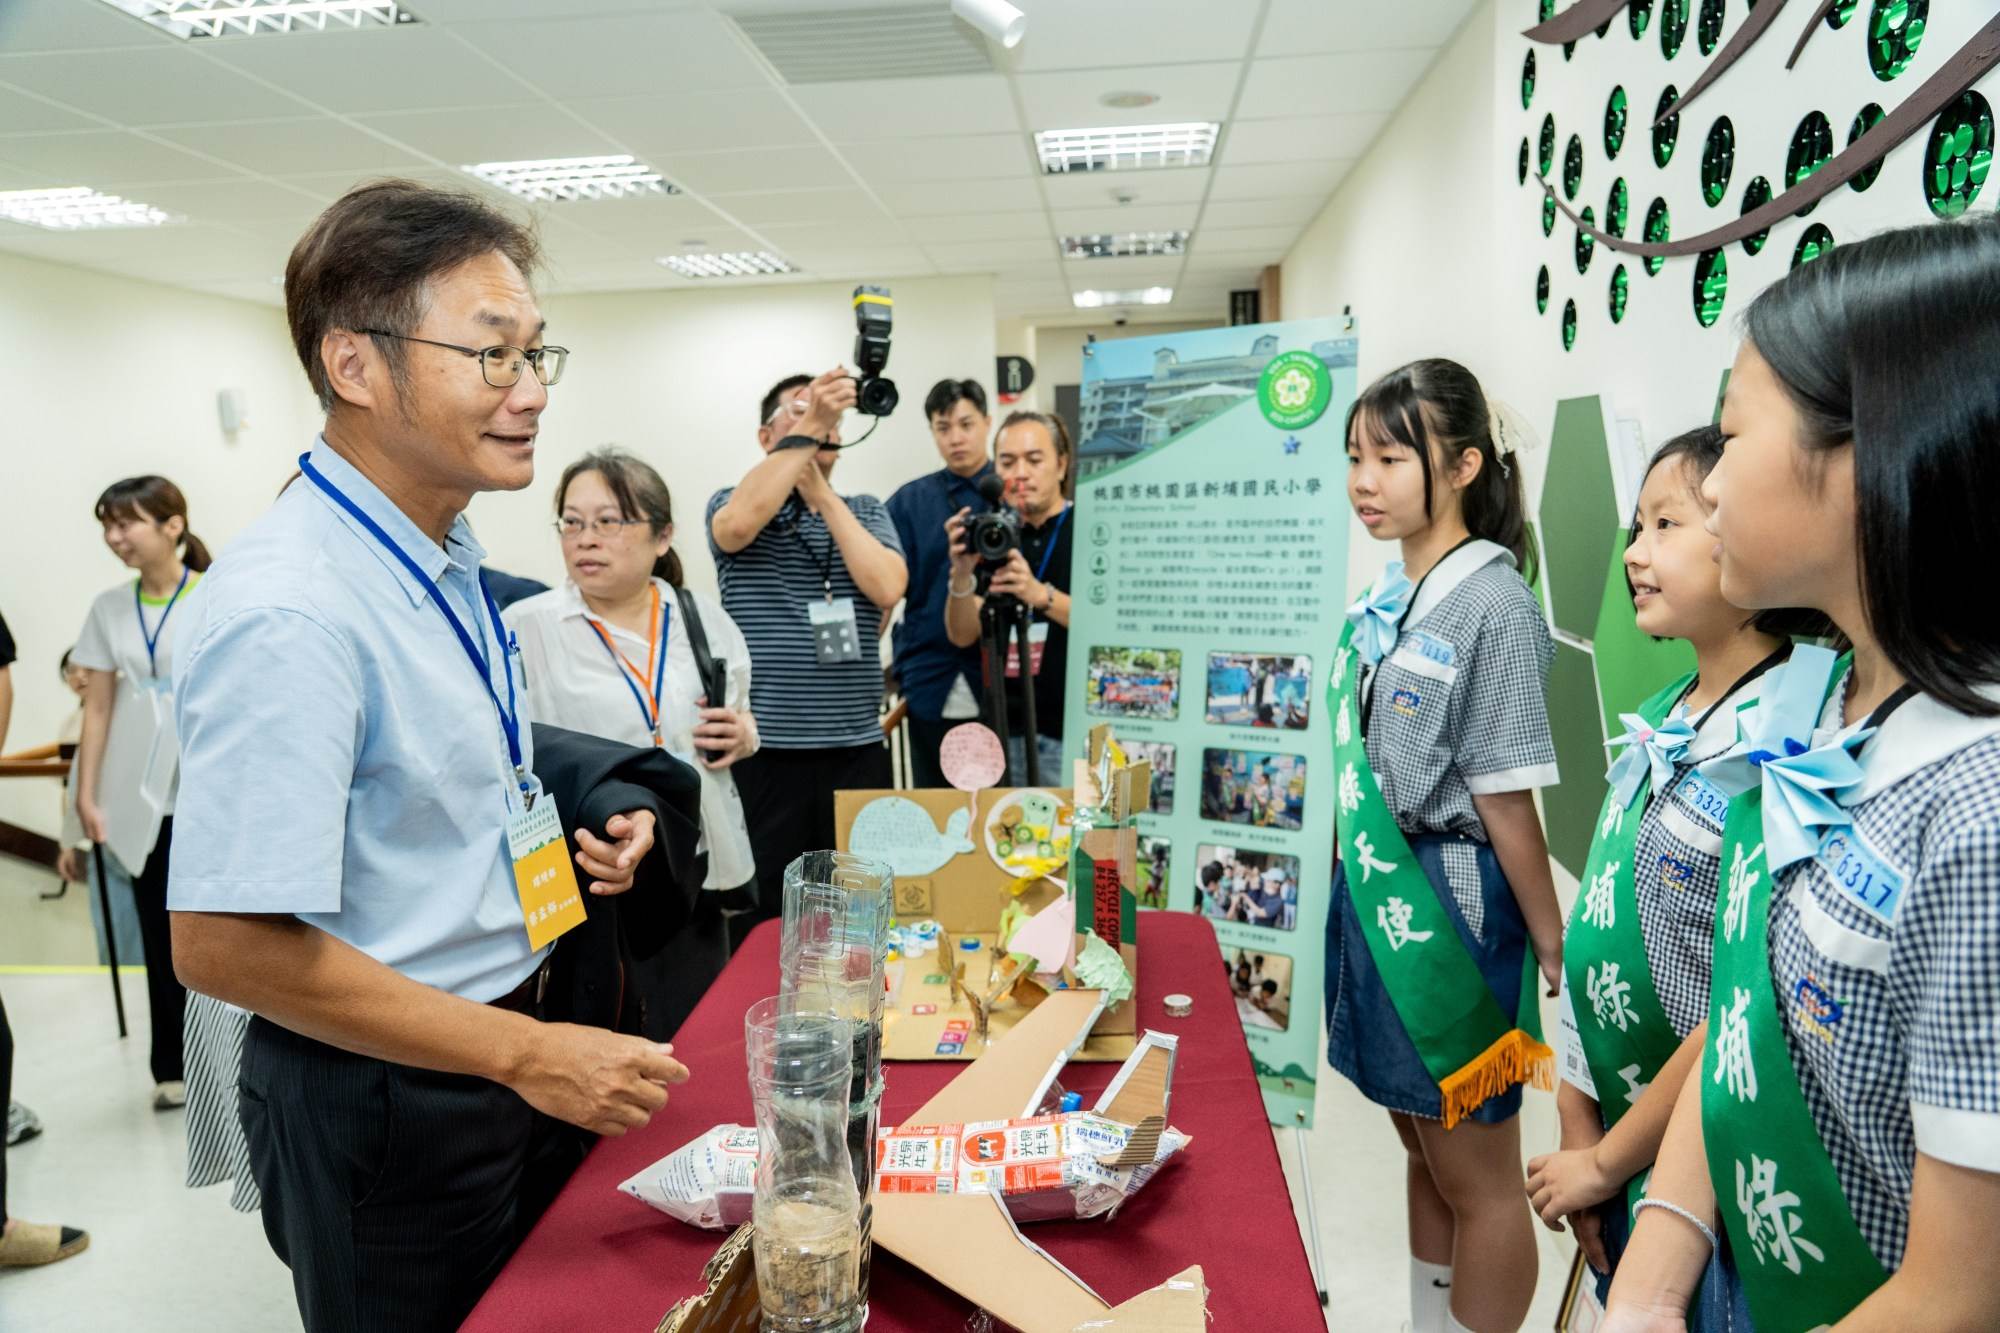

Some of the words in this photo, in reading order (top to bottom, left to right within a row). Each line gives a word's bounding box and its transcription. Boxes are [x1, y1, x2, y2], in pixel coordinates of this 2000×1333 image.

[1093, 478, 1321, 500] 桃園市桃園區新埔國民小學
[1330, 646, 1434, 951] 新埔綠天使
[1836, 853, 1893, 908] 6317
[898, 1140, 913, 1168] 光泉
[914, 1139, 929, 1168] 牛乳
[1020, 1128, 1034, 1157] 光泉
[1036, 1127, 1050, 1156] 牛乳
